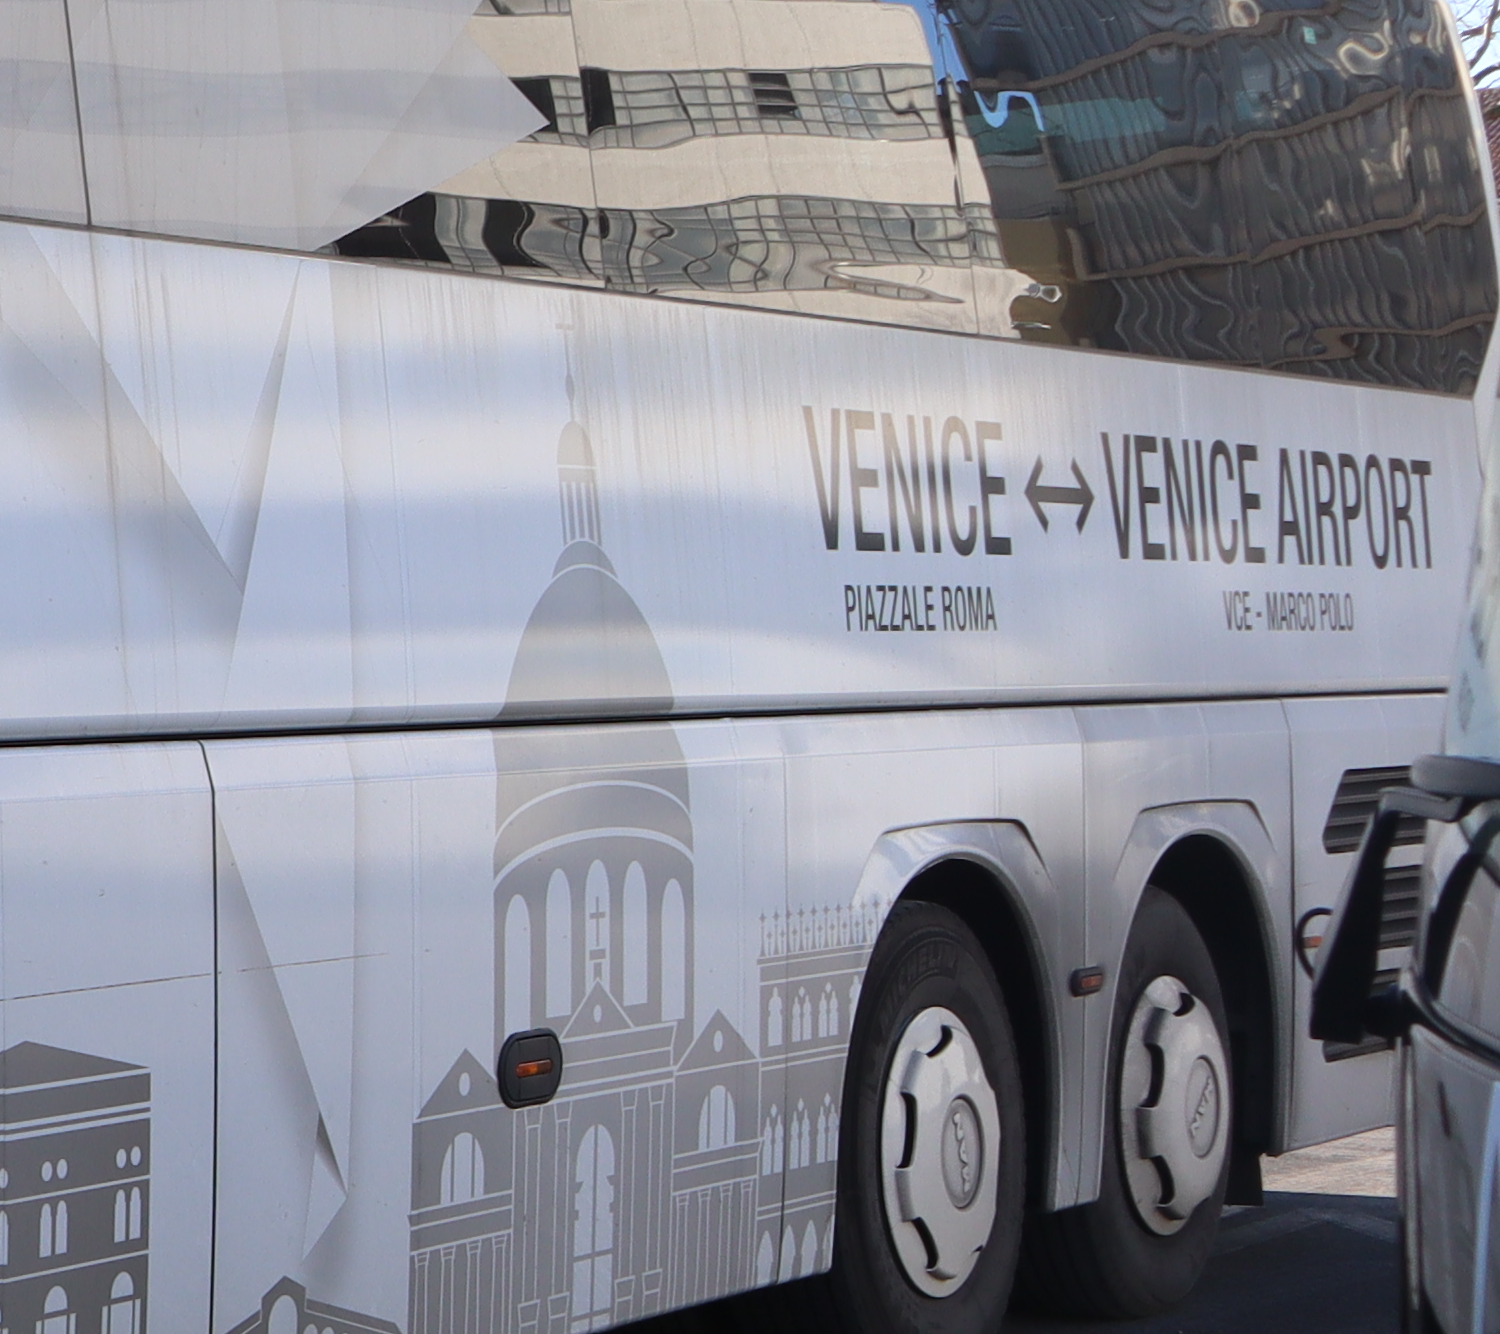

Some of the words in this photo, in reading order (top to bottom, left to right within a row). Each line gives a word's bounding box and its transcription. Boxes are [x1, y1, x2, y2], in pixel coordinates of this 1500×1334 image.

[803, 405, 1012, 556] VENICE
[1100, 431, 1266, 564] VENICE
[1277, 448, 1432, 570] AIRPORT
[844, 584, 935, 633] PIAZZALE
[942, 584, 997, 632] ROMA
[1222, 590, 1252, 631] VCE
[1266, 590, 1316, 632] MARCO
[1319, 591, 1354, 632] POLO
